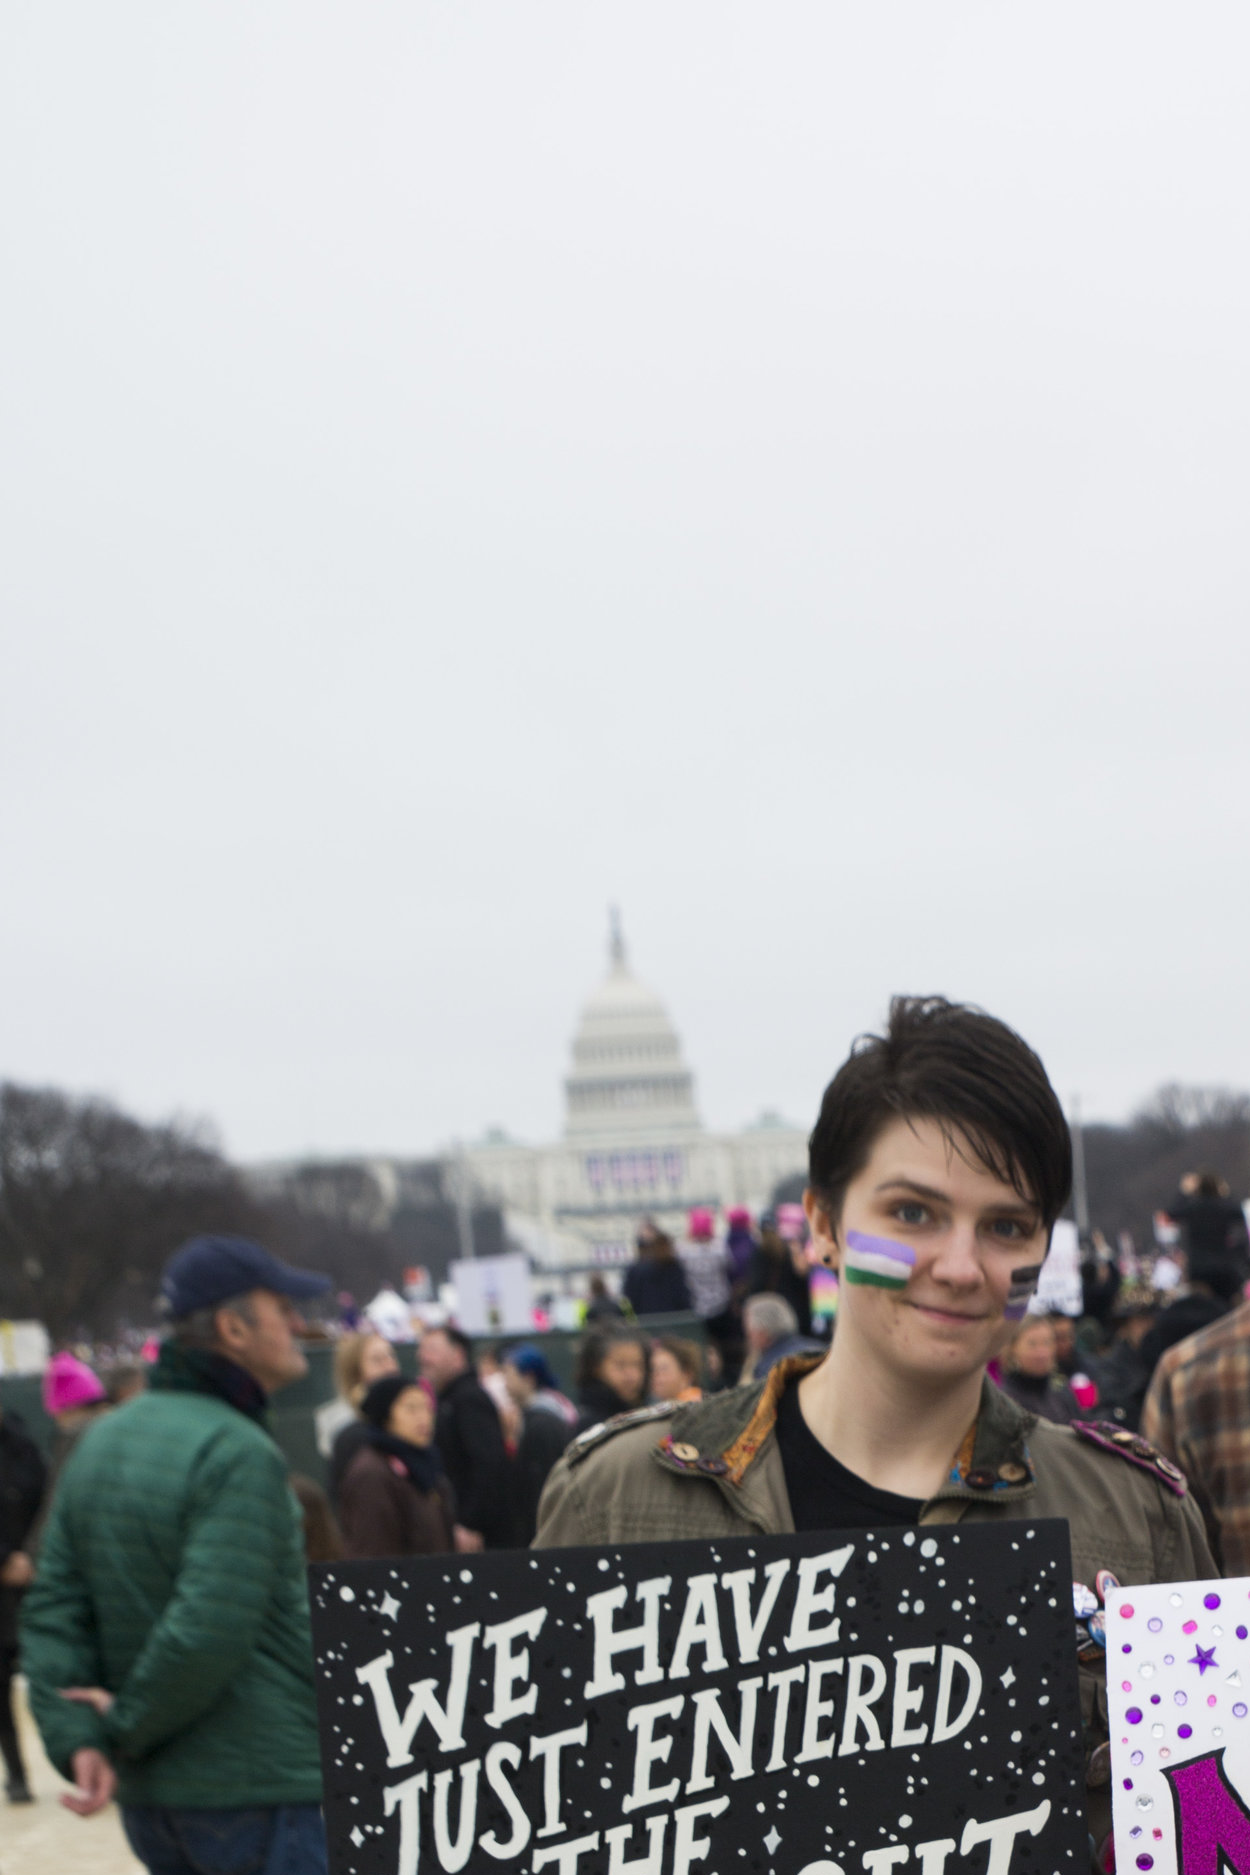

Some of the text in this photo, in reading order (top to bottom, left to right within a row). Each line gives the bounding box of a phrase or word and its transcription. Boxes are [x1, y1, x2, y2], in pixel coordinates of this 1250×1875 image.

[355, 1544, 855, 1768] WE HAVE
[622, 1645, 983, 1813] ENTERED
